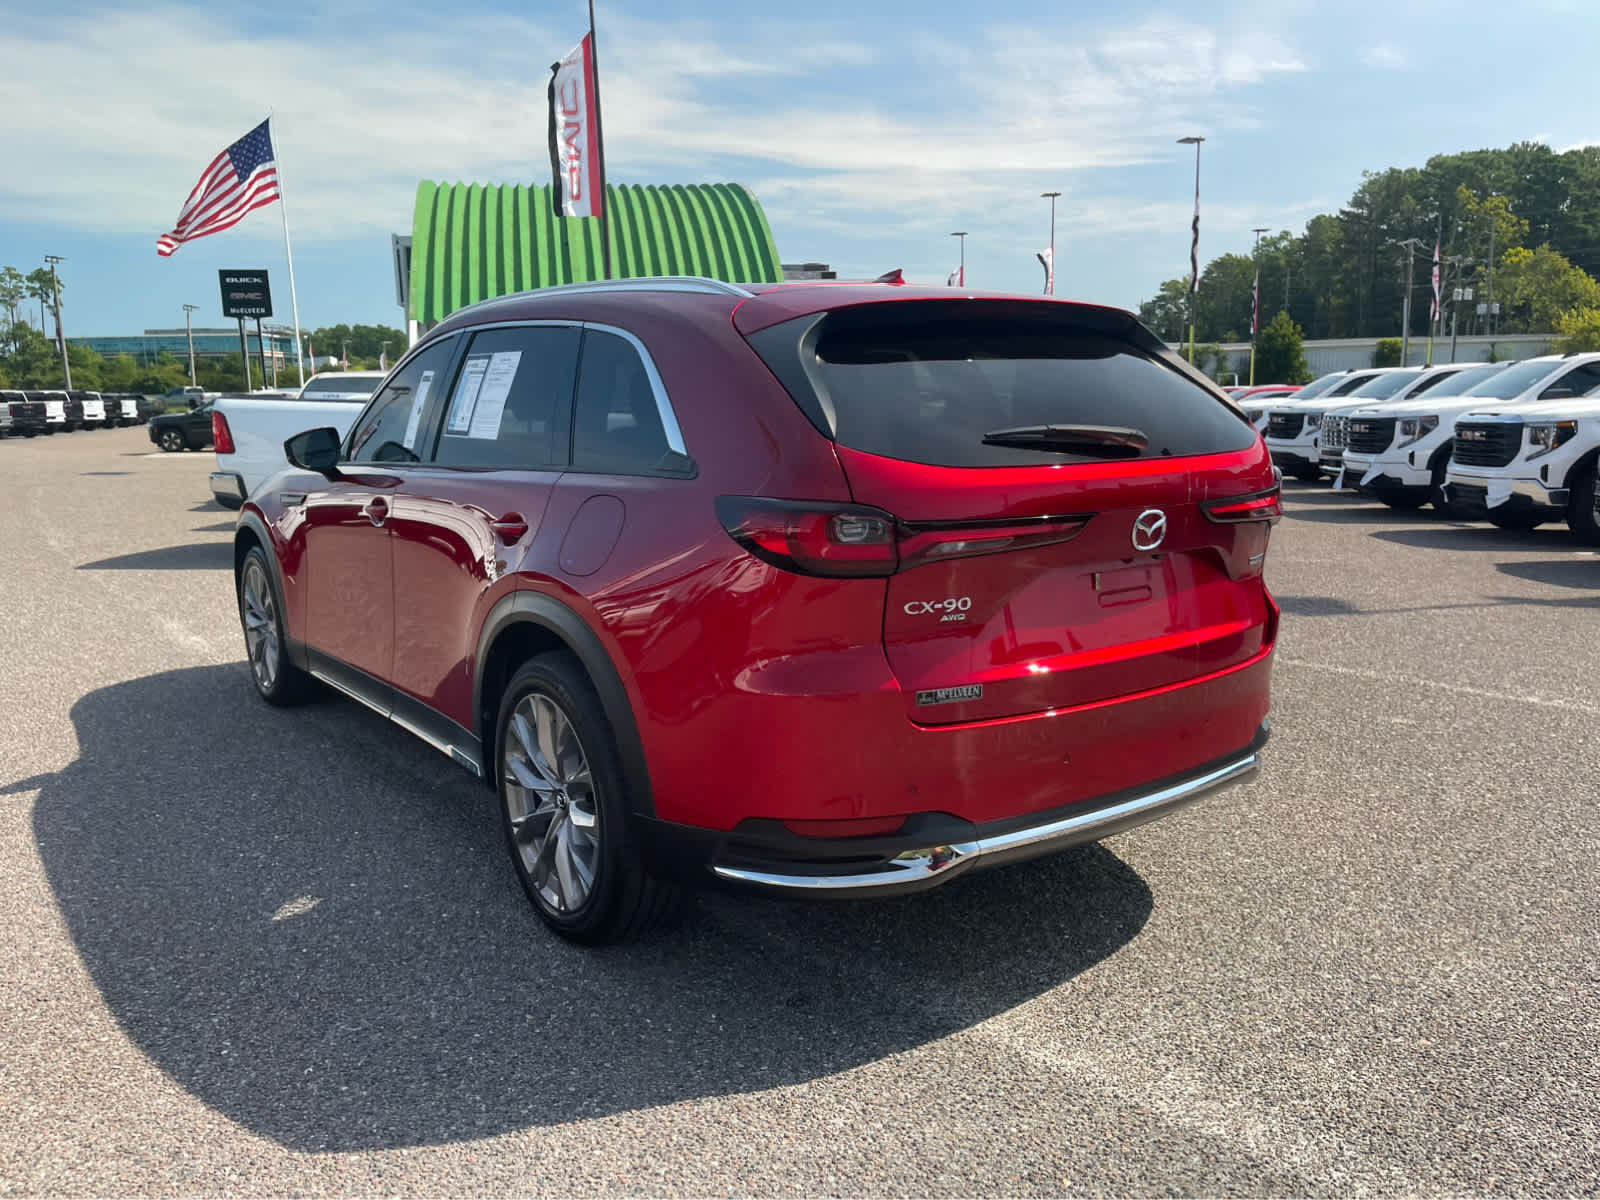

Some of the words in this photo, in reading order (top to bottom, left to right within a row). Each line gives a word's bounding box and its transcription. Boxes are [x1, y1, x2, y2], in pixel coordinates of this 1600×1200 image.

[230, 292, 264, 300] GMC
[903, 596, 972, 615] CX-90
[940, 613, 966, 622] AWD
